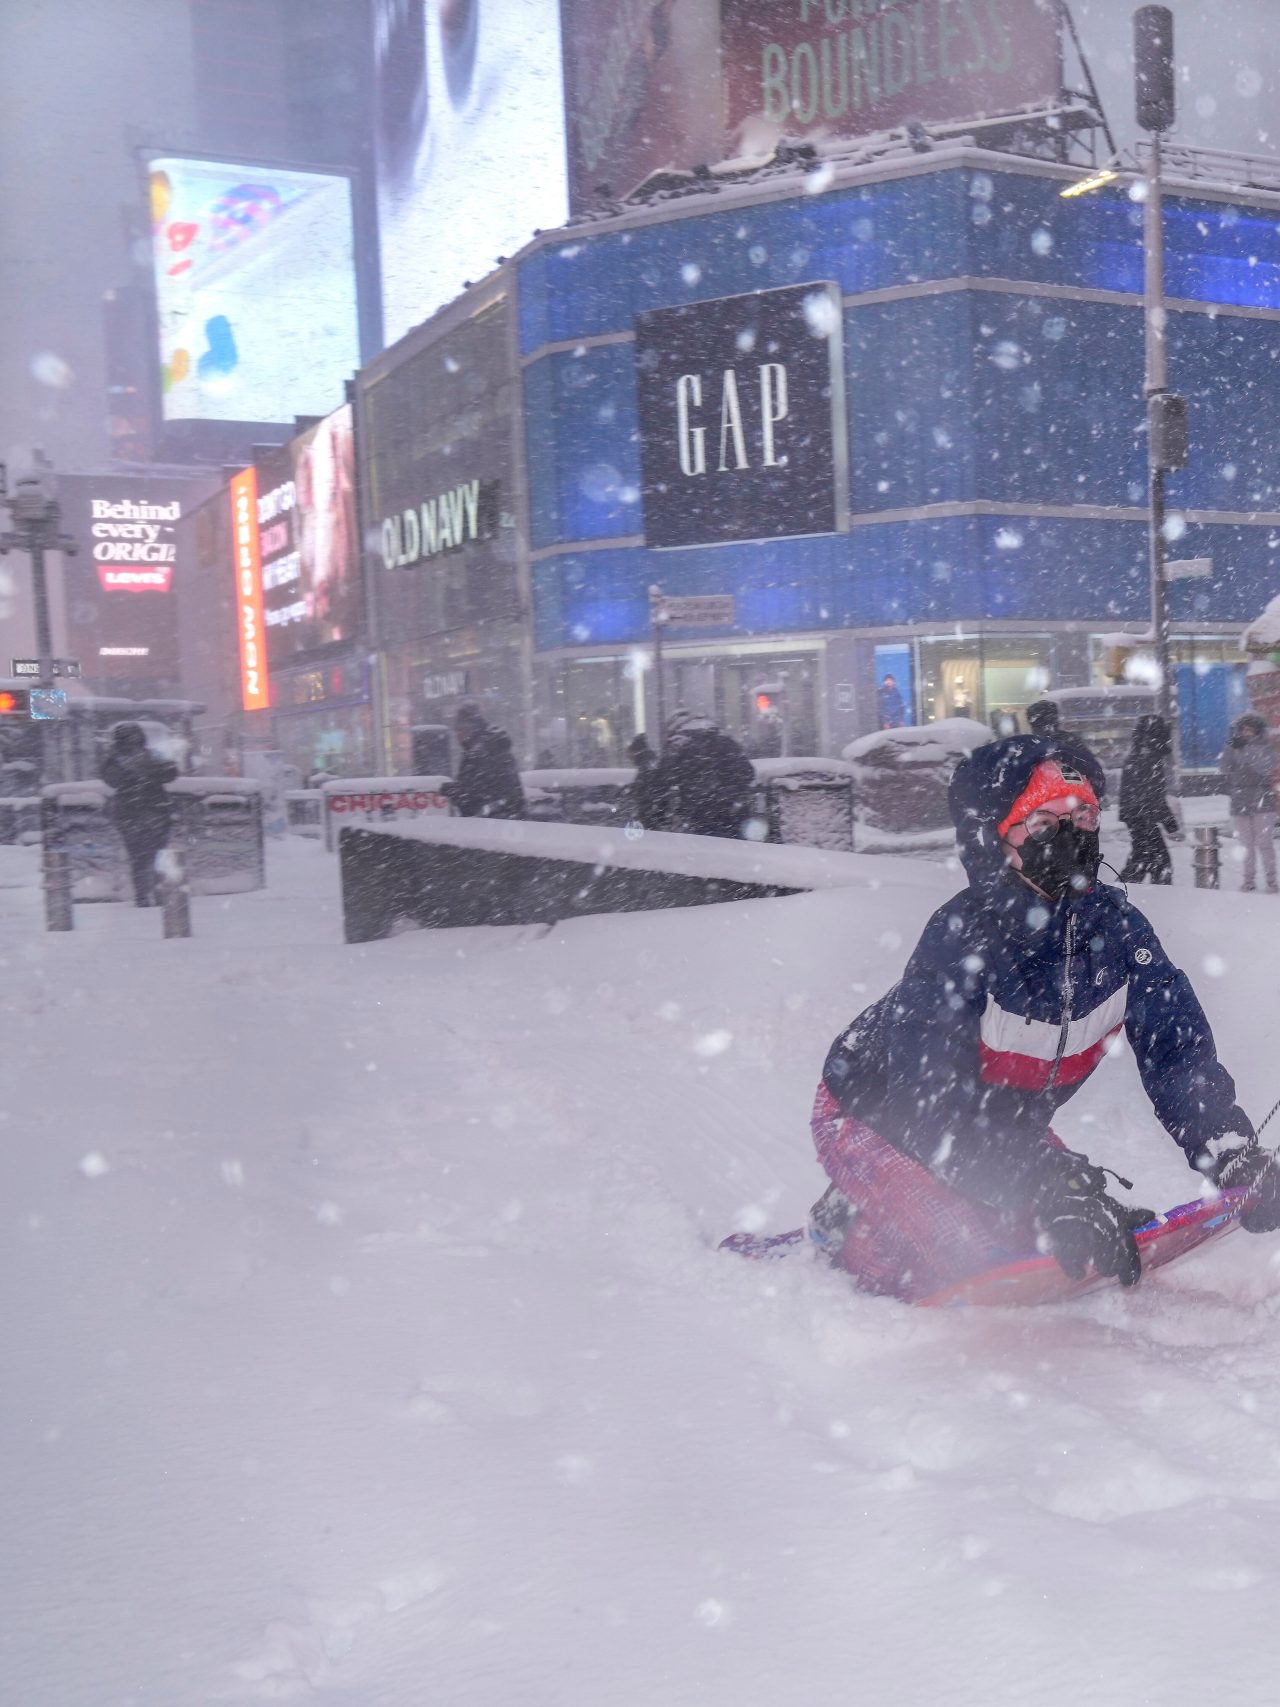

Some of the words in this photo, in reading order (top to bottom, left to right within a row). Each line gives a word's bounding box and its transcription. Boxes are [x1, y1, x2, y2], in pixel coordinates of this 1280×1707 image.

[762, 0, 1013, 124] BOUNDLESS
[676, 363, 789, 477] GAP
[91, 499, 181, 521] Behind
[91, 522, 161, 543] every
[382, 508, 420, 570] OLD
[421, 480, 480, 557] NAVY
[242, 605, 259, 695] NOW
